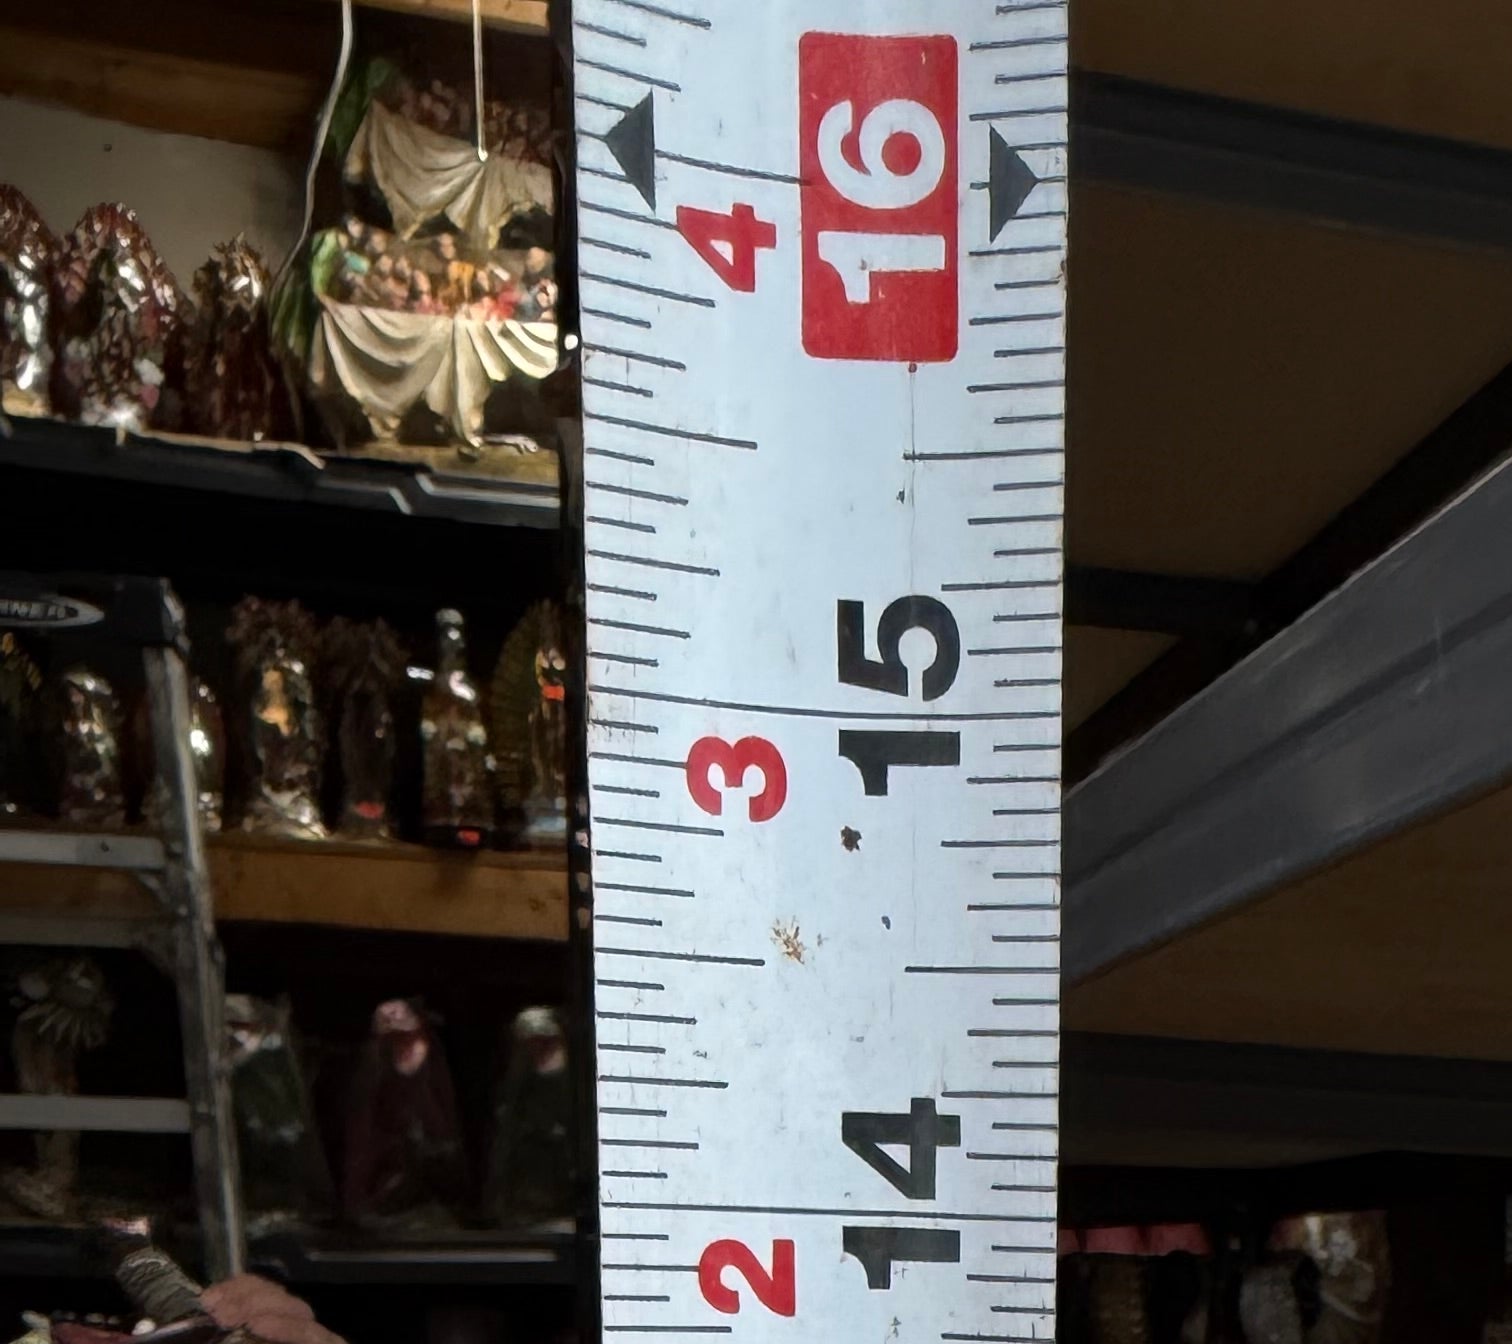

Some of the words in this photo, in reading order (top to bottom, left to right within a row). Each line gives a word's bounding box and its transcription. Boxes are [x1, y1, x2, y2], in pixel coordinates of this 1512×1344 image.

[676, 203, 778, 293] 4
[815, 97, 947, 305] 16
[837, 595, 961, 797] 15
[686, 735, 788, 822] 3
[841, 1097, 961, 1290] 14
[698, 1238, 796, 1318] 2
